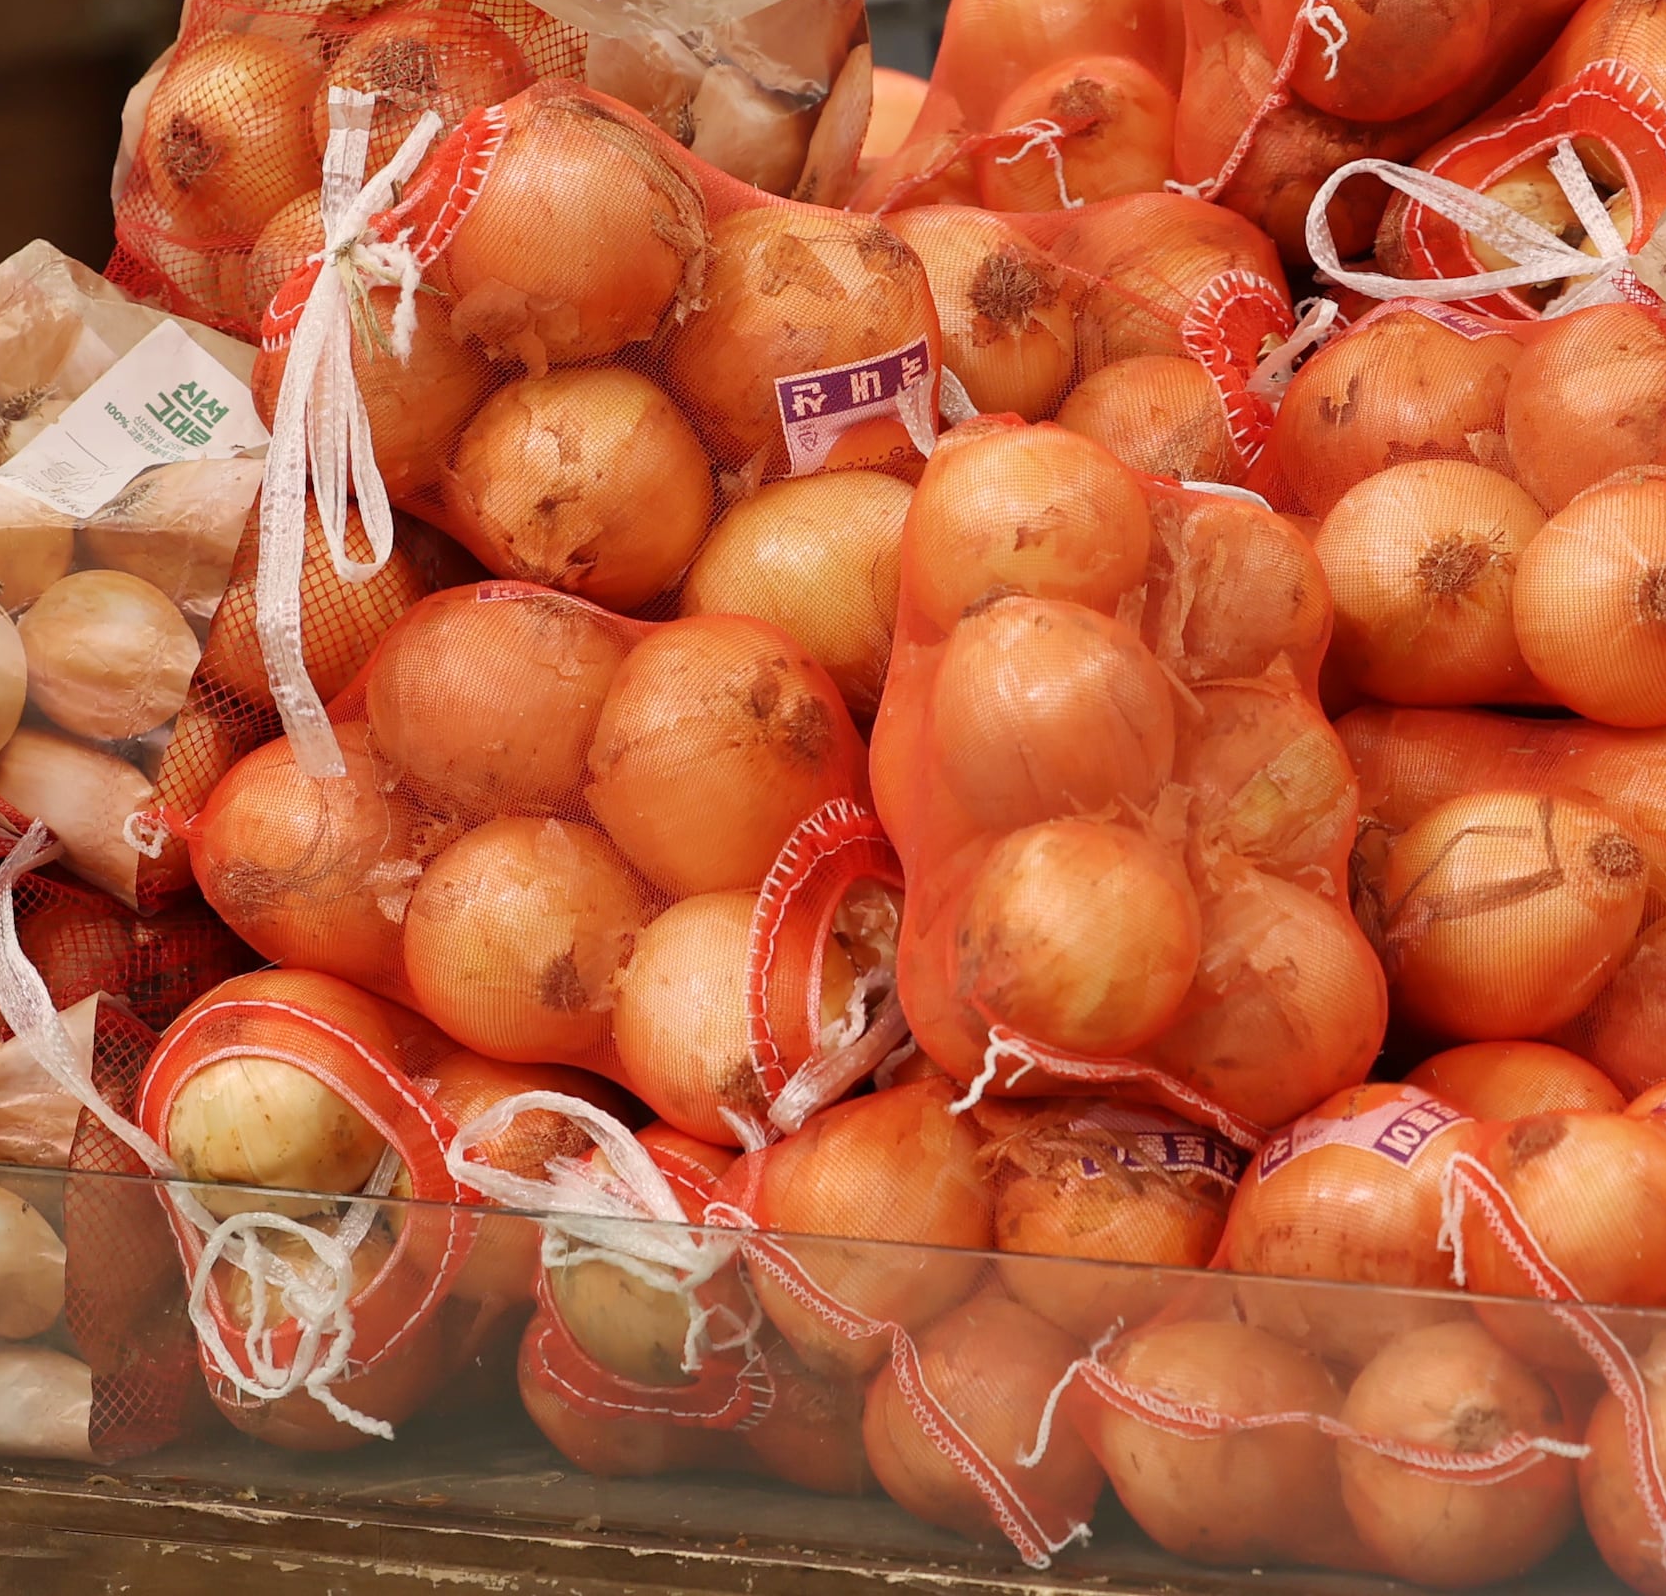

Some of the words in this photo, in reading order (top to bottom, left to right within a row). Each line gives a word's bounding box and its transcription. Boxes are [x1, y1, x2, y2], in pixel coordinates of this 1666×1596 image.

[103, 401, 129, 429] 100%
[145, 391, 213, 447] 그대로
[172, 380, 230, 429] 신선
[132, 414, 165, 444] 신선하지
